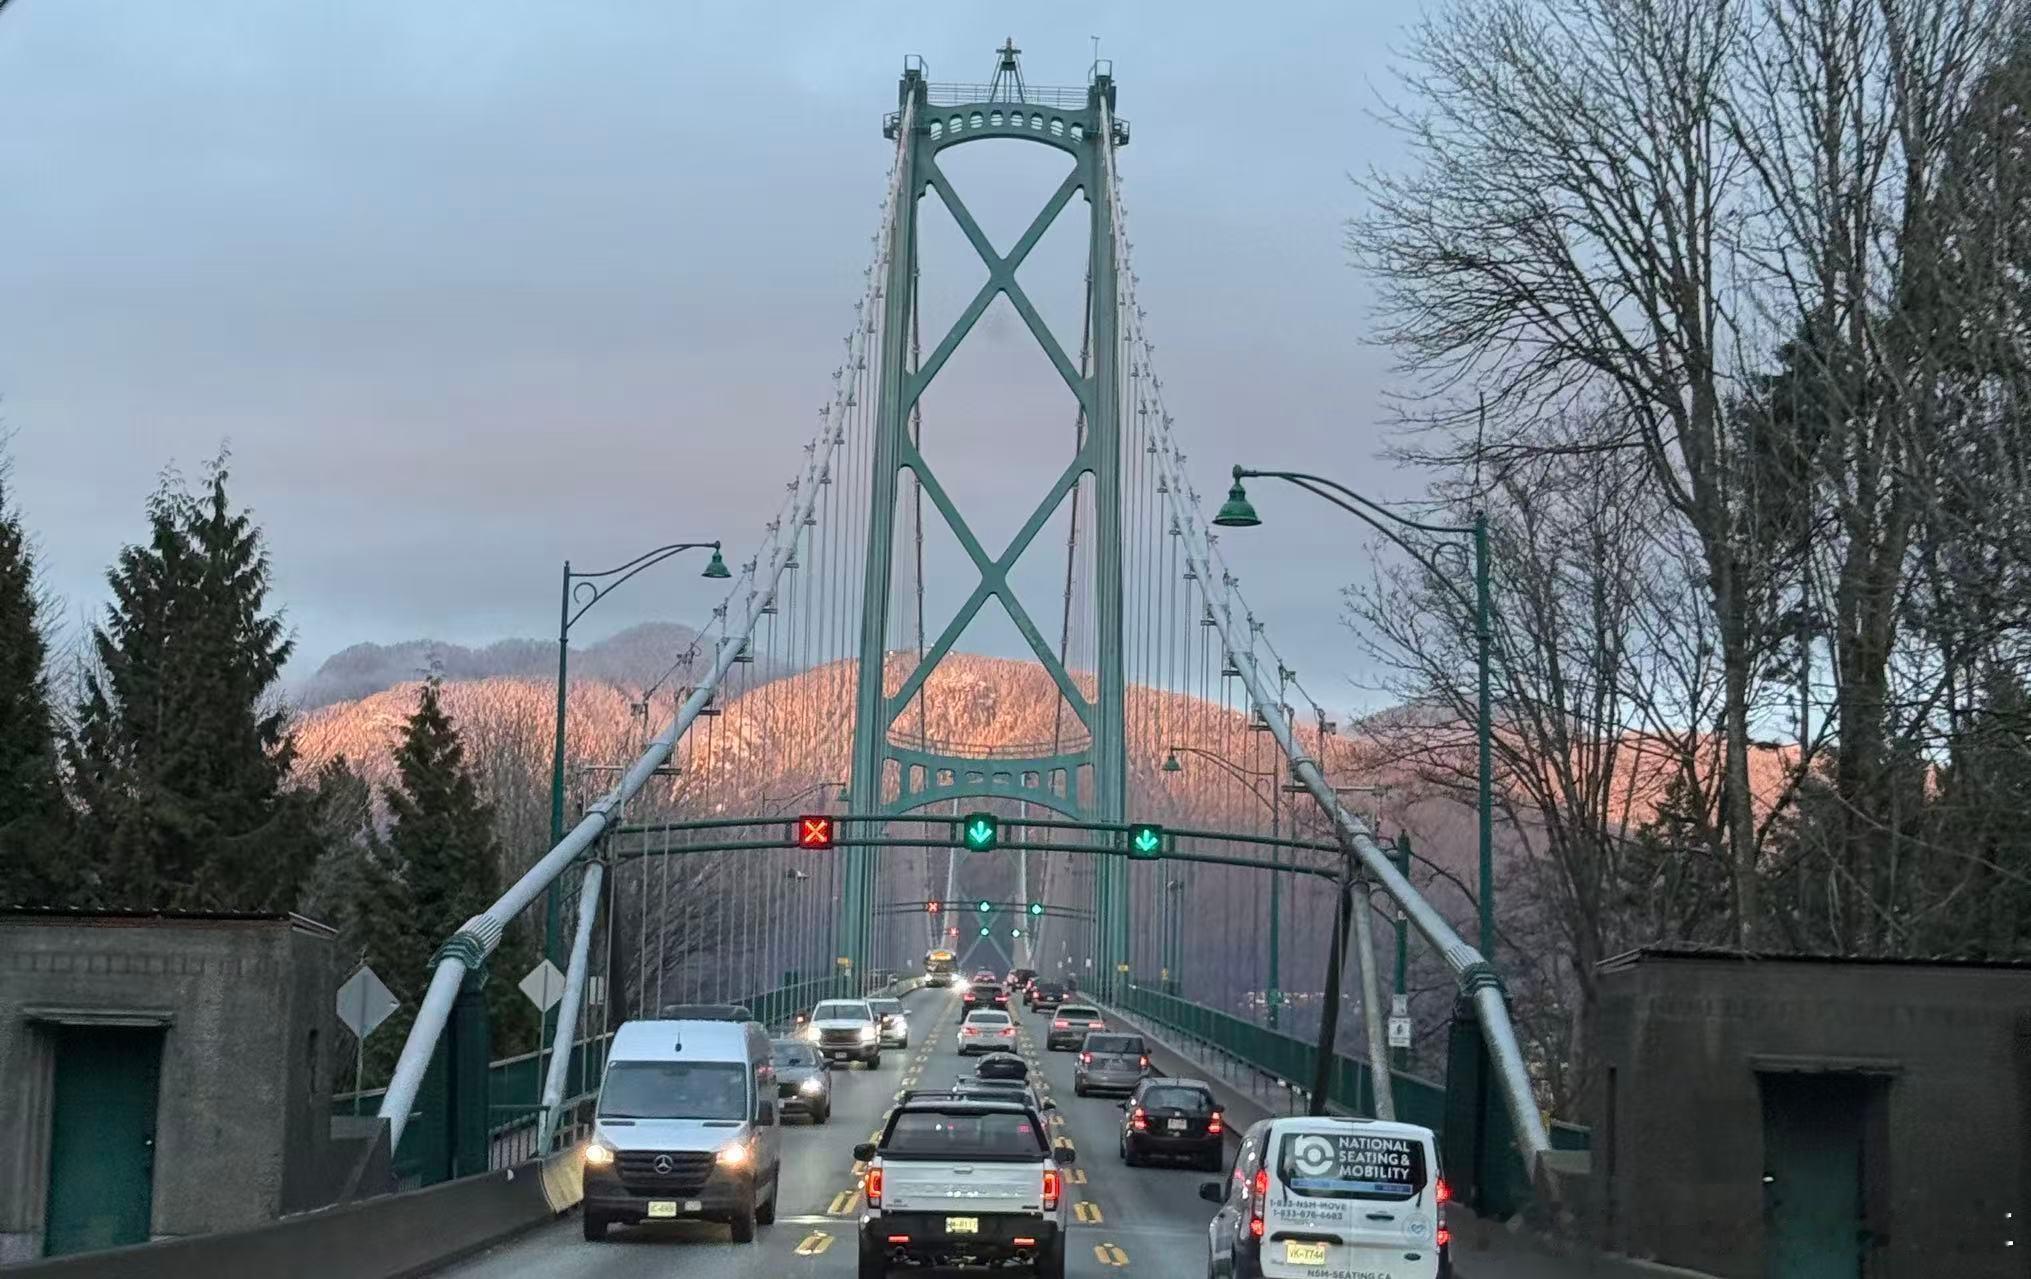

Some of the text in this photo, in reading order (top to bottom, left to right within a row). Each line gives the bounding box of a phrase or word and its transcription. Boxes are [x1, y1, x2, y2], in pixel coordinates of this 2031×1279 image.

[1338, 1136, 1410, 1152] NATIONAL
[1338, 1150, 1410, 1166] SEATING &
[1338, 1164, 1410, 1180] MOBILITY
